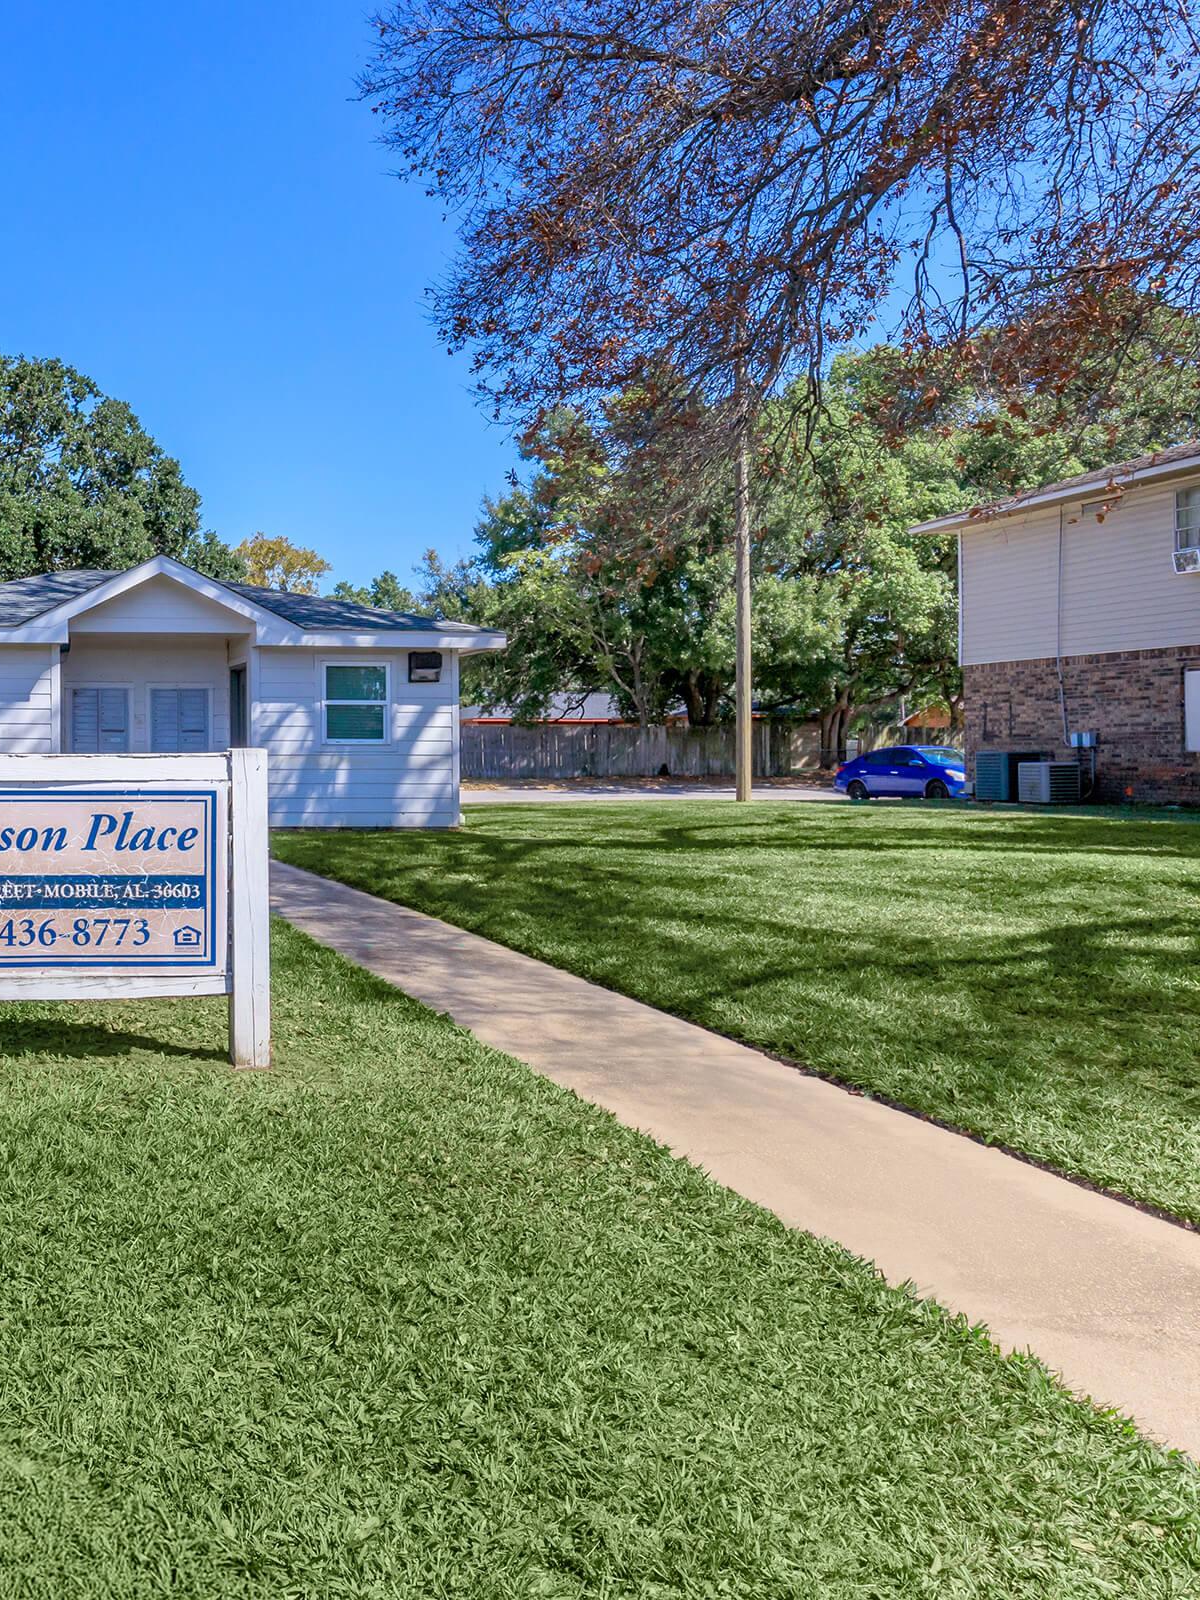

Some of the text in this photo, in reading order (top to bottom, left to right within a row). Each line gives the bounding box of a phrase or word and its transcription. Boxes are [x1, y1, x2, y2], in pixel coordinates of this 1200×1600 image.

[81, 811, 199, 851] Place
[122, 884, 150, 899] AL.
[153, 883, 201, 899] 36603
